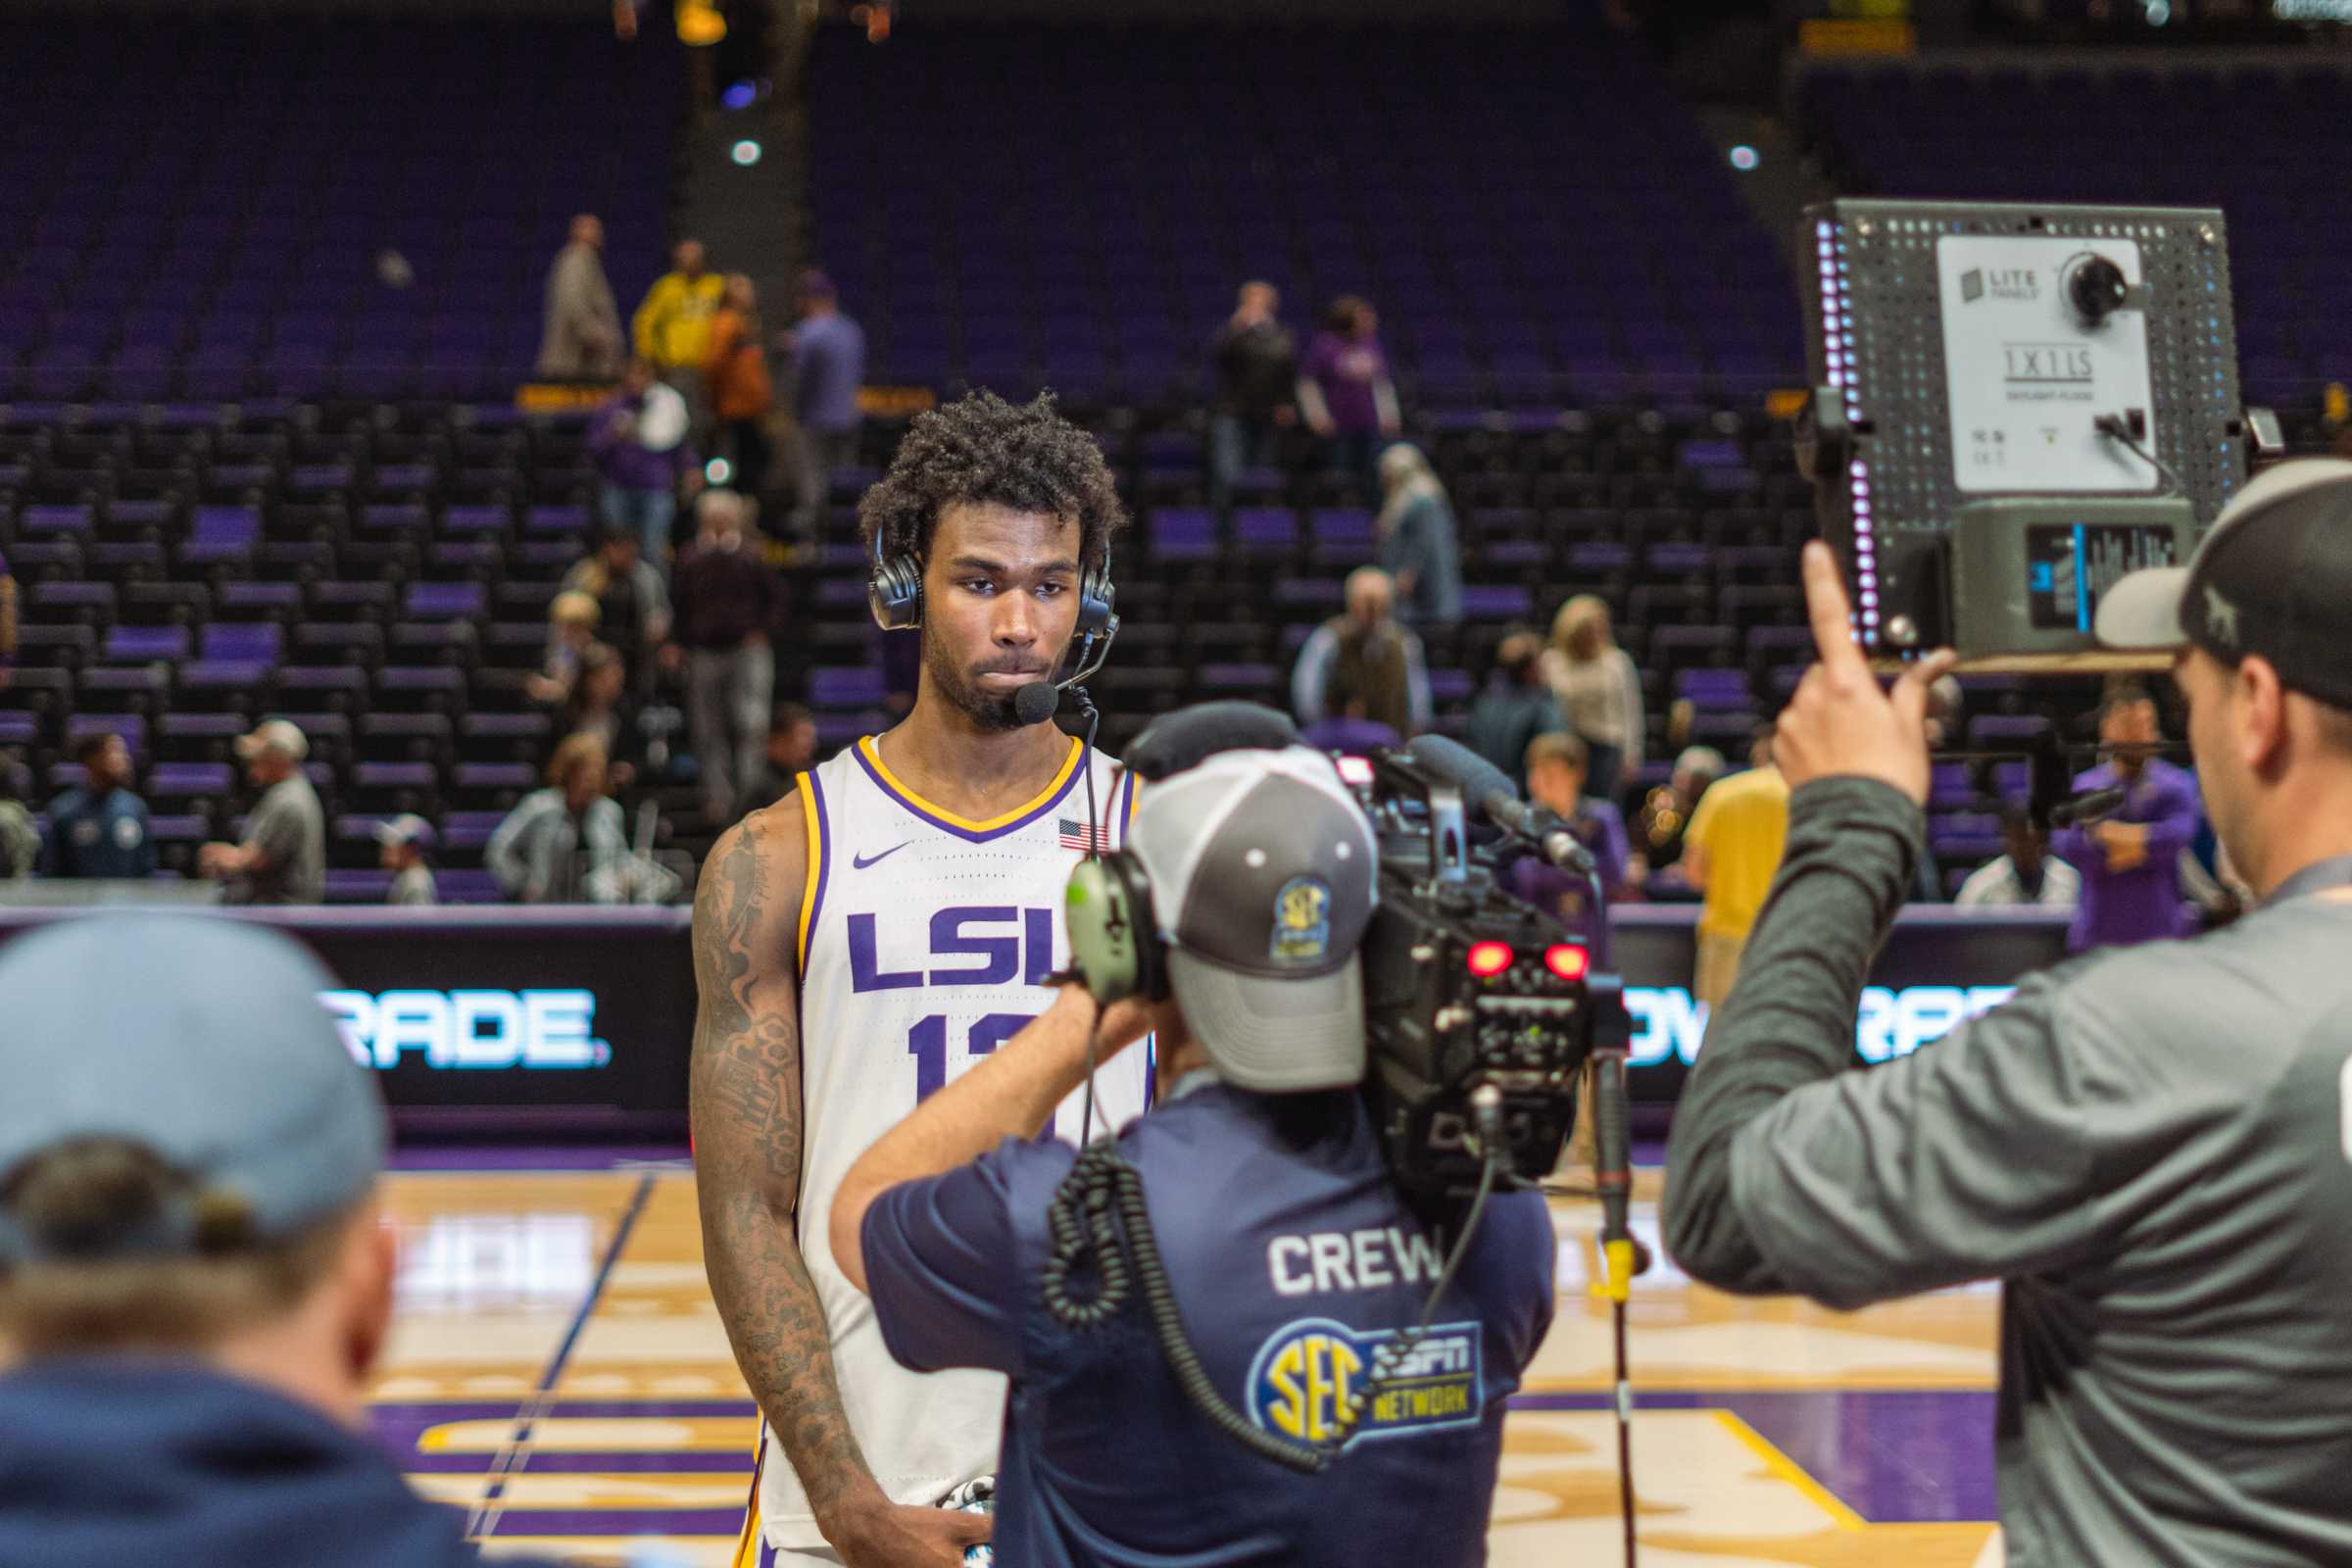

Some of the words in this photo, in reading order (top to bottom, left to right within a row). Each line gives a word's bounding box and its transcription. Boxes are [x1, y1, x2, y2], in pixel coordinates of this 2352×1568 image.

[1989, 270, 2036, 286] LITE
[1268, 1227, 1446, 1296] CREW
[1267, 1334, 1363, 1440] SEC
[1374, 1385, 1468, 1421] NETWORK
